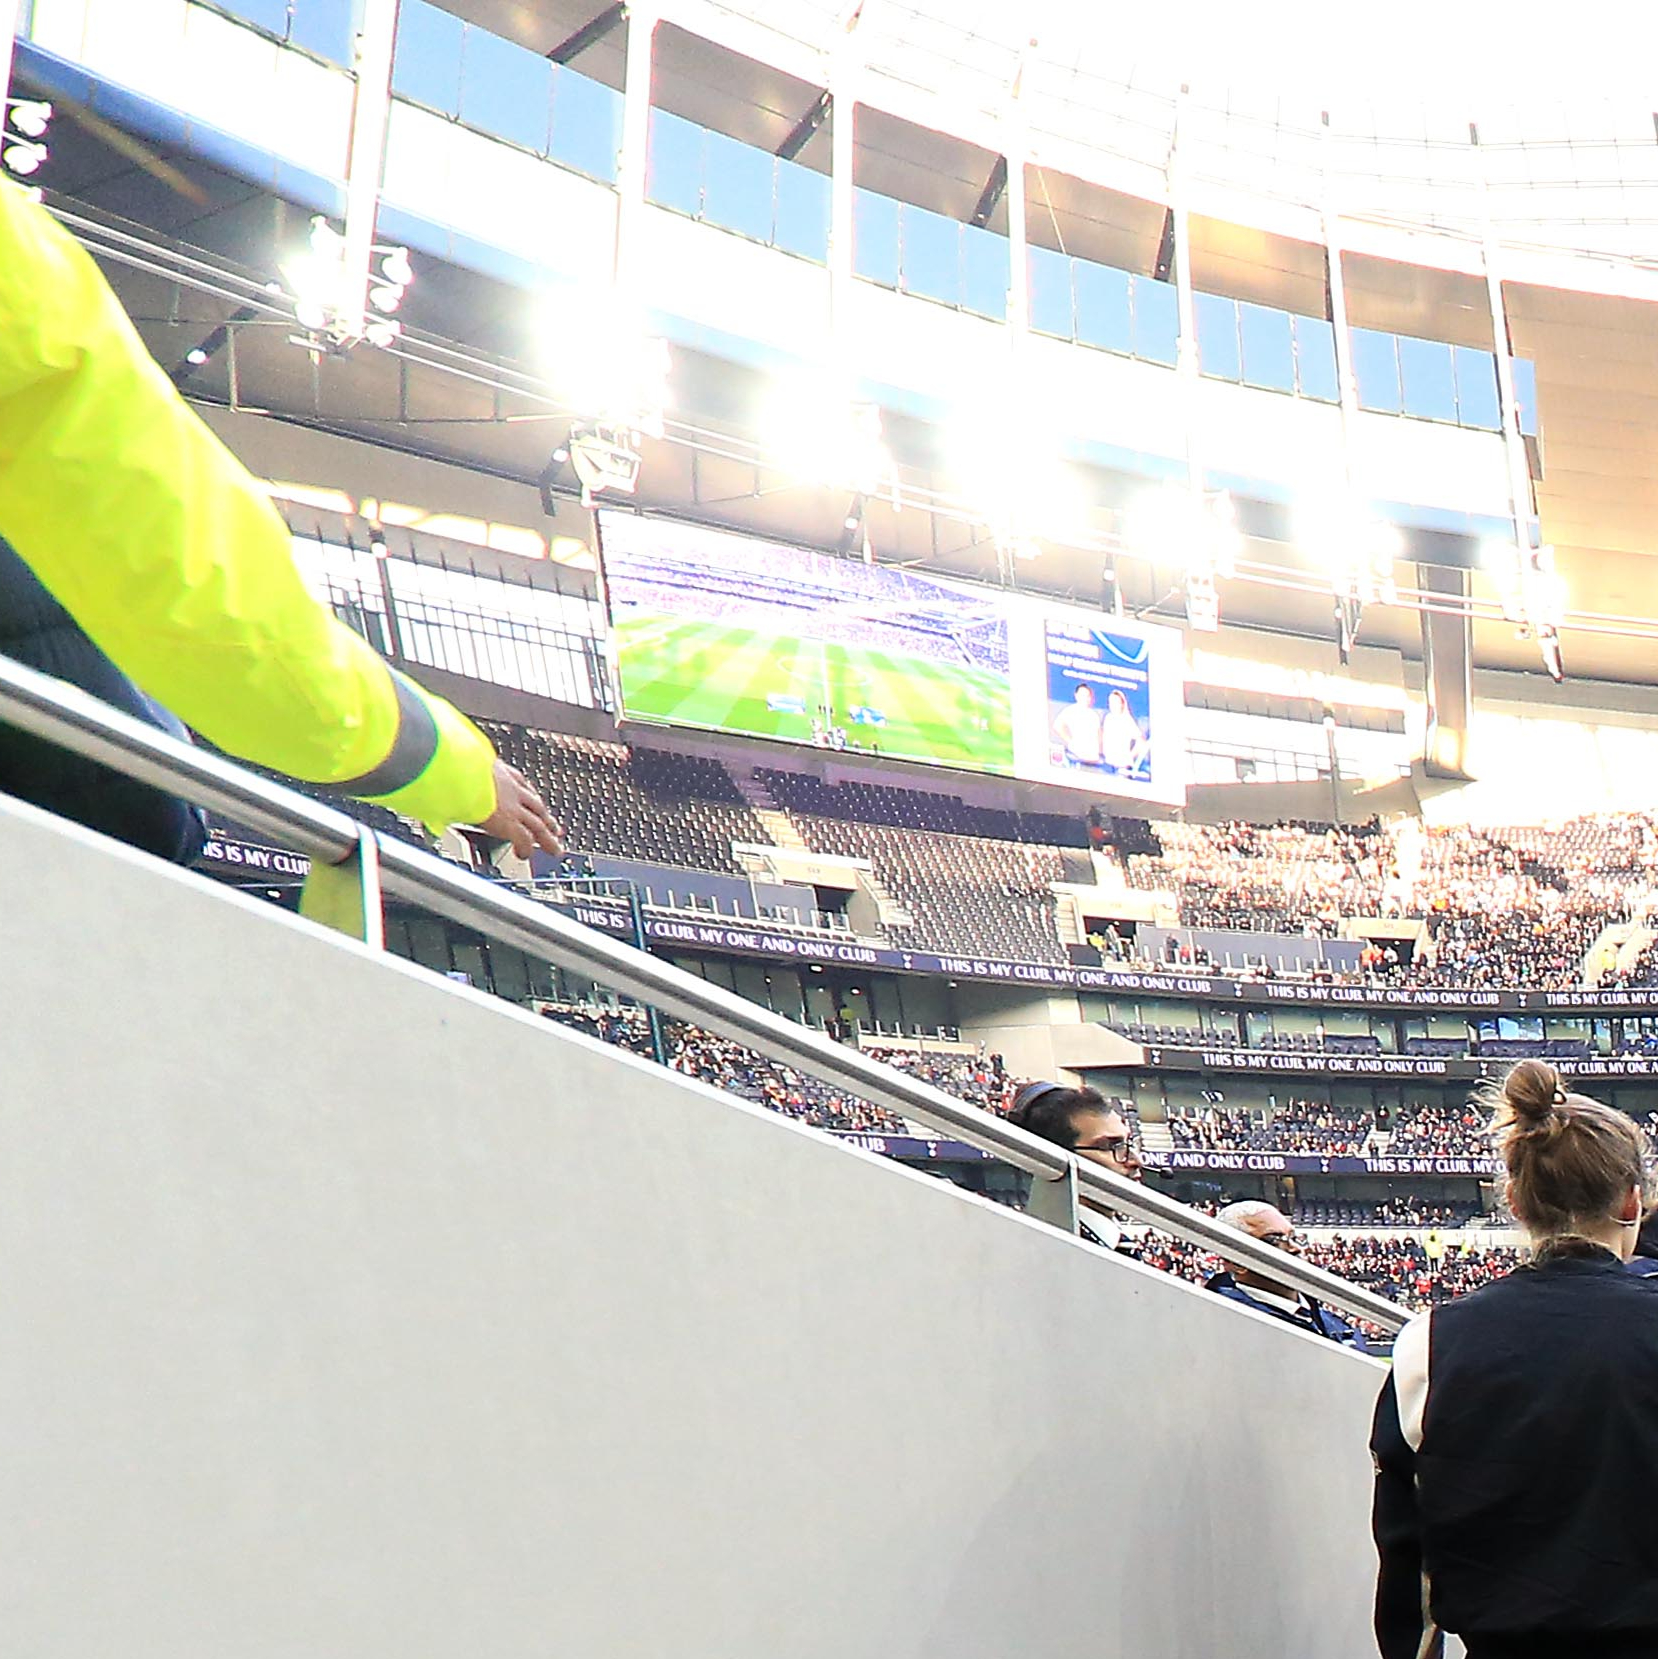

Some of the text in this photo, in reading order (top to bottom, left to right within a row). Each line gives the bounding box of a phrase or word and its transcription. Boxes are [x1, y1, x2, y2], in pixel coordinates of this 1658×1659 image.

[203, 841, 224, 859] IS
[225, 844, 243, 863] IS
[244, 848, 270, 868] MY
[573, 906, 607, 926] THIS
[609, 911, 624, 928] IS
[699, 925, 722, 943] MY
[726, 928, 759, 948] ONE
[762, 933, 795, 952] AND
[797, 938, 834, 958] ONLY
[837, 944, 879, 964] CLUB
[940, 958, 971, 975] THIS
[973, 961, 987, 976] IS
[989, 962, 1012, 978] MY
[1054, 967, 1077, 982] MY
[1079, 970, 1108, 985] ONE
[1111, 972, 1139, 987] AND
[1142, 975, 1173, 990] ONLY
[1177, 978, 1213, 993] CLUB
[1547, 992, 1569, 1005] THIS
[1571, 992, 1581, 1005] IS
[1582, 992, 1598, 1005] MY
[1631, 992, 1647, 1004] MY
[1203, 1053, 1231, 1067] THIS
[1233, 1054, 1245, 1068] IS
[1248, 1054, 1267, 1068] MY
[1306, 1056, 1325, 1070] MY
[1328, 1056, 1354, 1071] ONE
[1356, 1057, 1382, 1071] AND
[1384, 1058, 1413, 1072] ONLY
[1416, 1059, 1448, 1073] CLUB
[1139, 1149, 1284, 1170] ONE AND ONLY CLUB
[1366, 1158, 1395, 1172] THIS
[1397, 1158, 1410, 1172] IS
[1413, 1158, 1432, 1172] MY
[1473, 1159, 1493, 1173] MY
